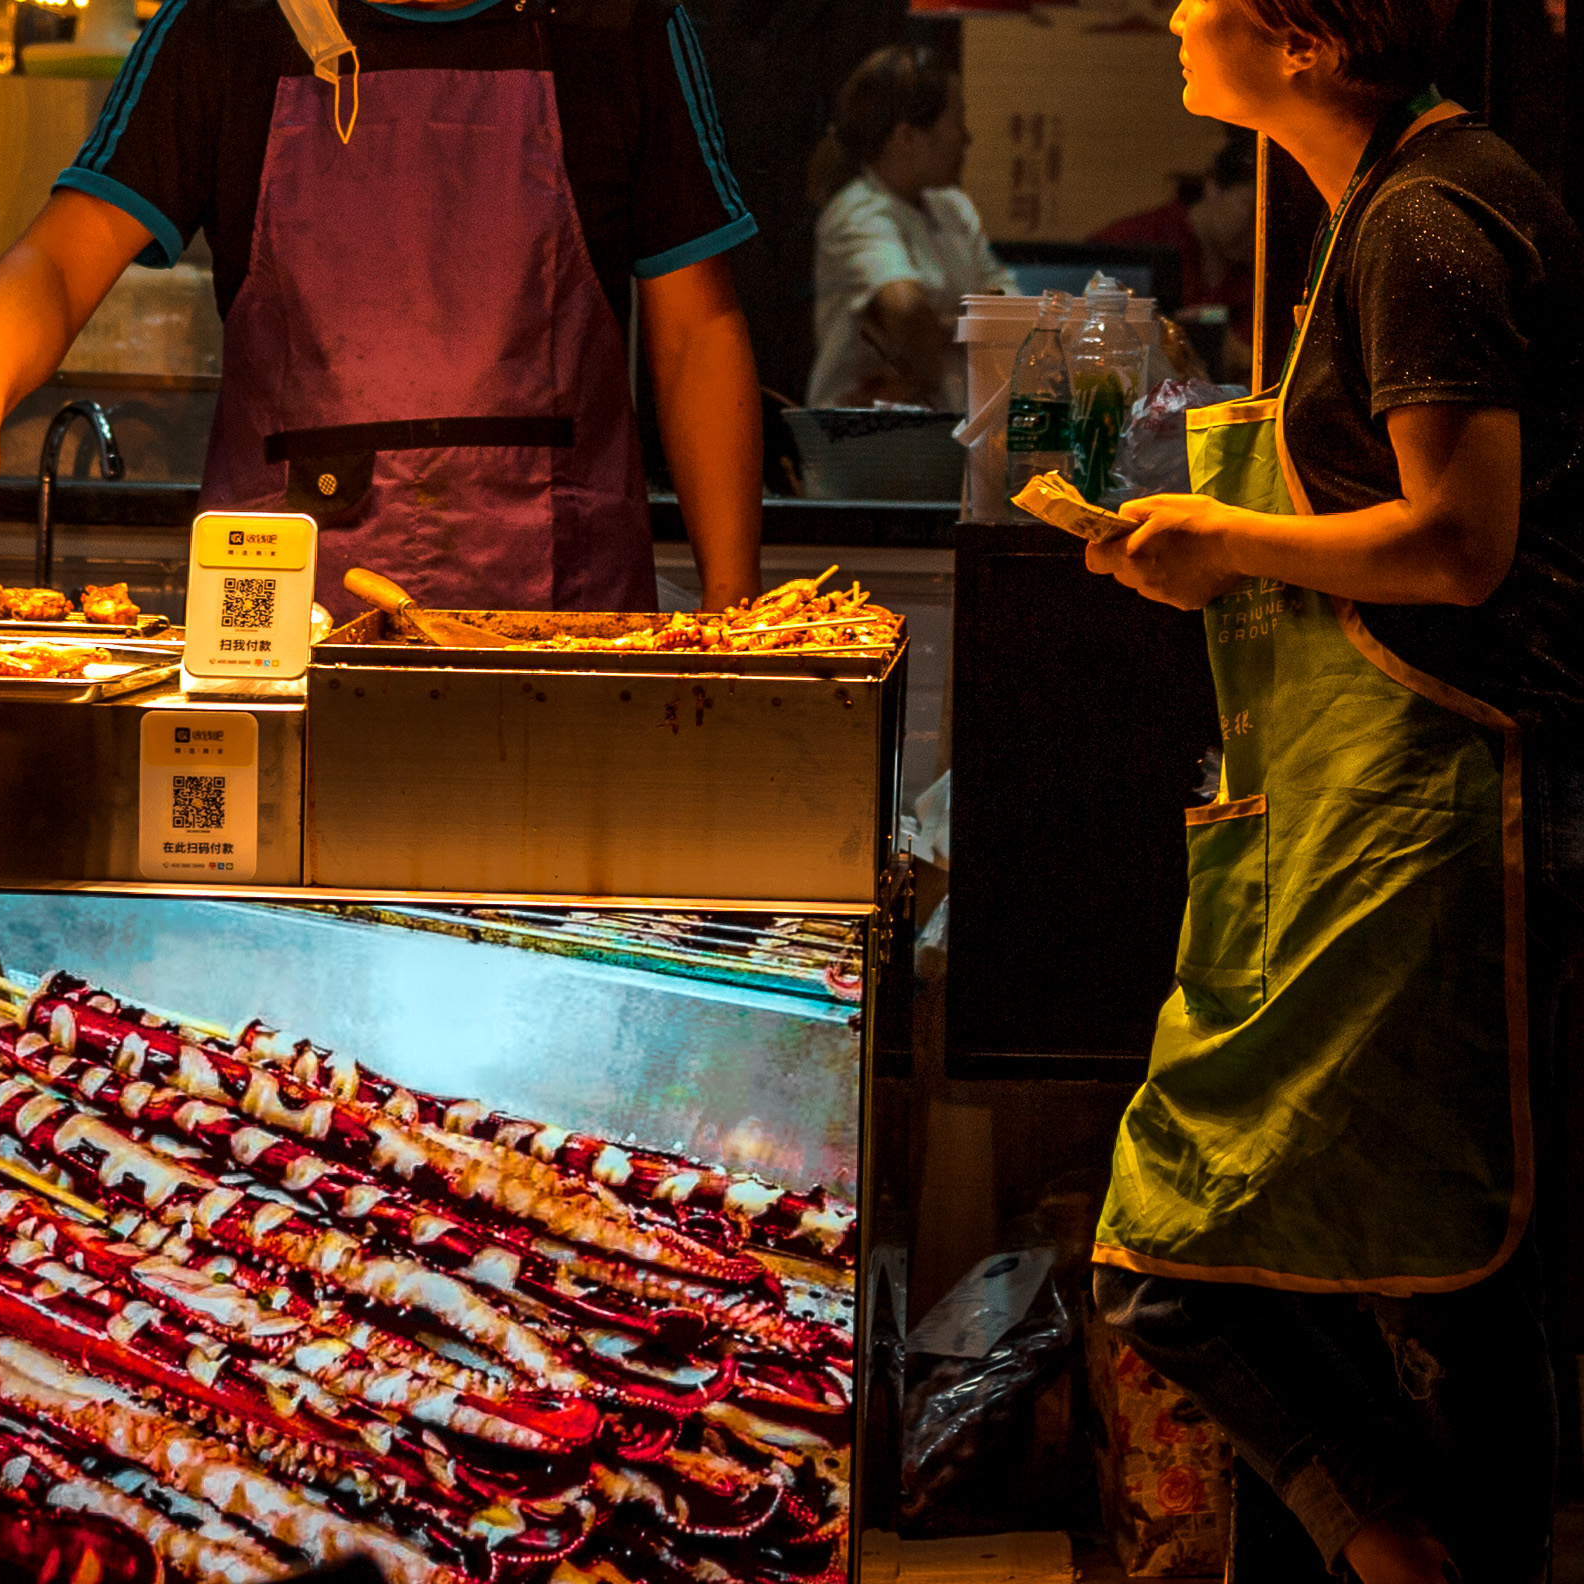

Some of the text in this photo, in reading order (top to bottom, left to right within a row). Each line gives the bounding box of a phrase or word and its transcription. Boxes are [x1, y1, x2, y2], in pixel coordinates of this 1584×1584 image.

[1218, 617, 1278, 644] GROUP
[219, 638, 273, 652] 扫我付款
[163, 841, 234, 855] 在此扫码付款
